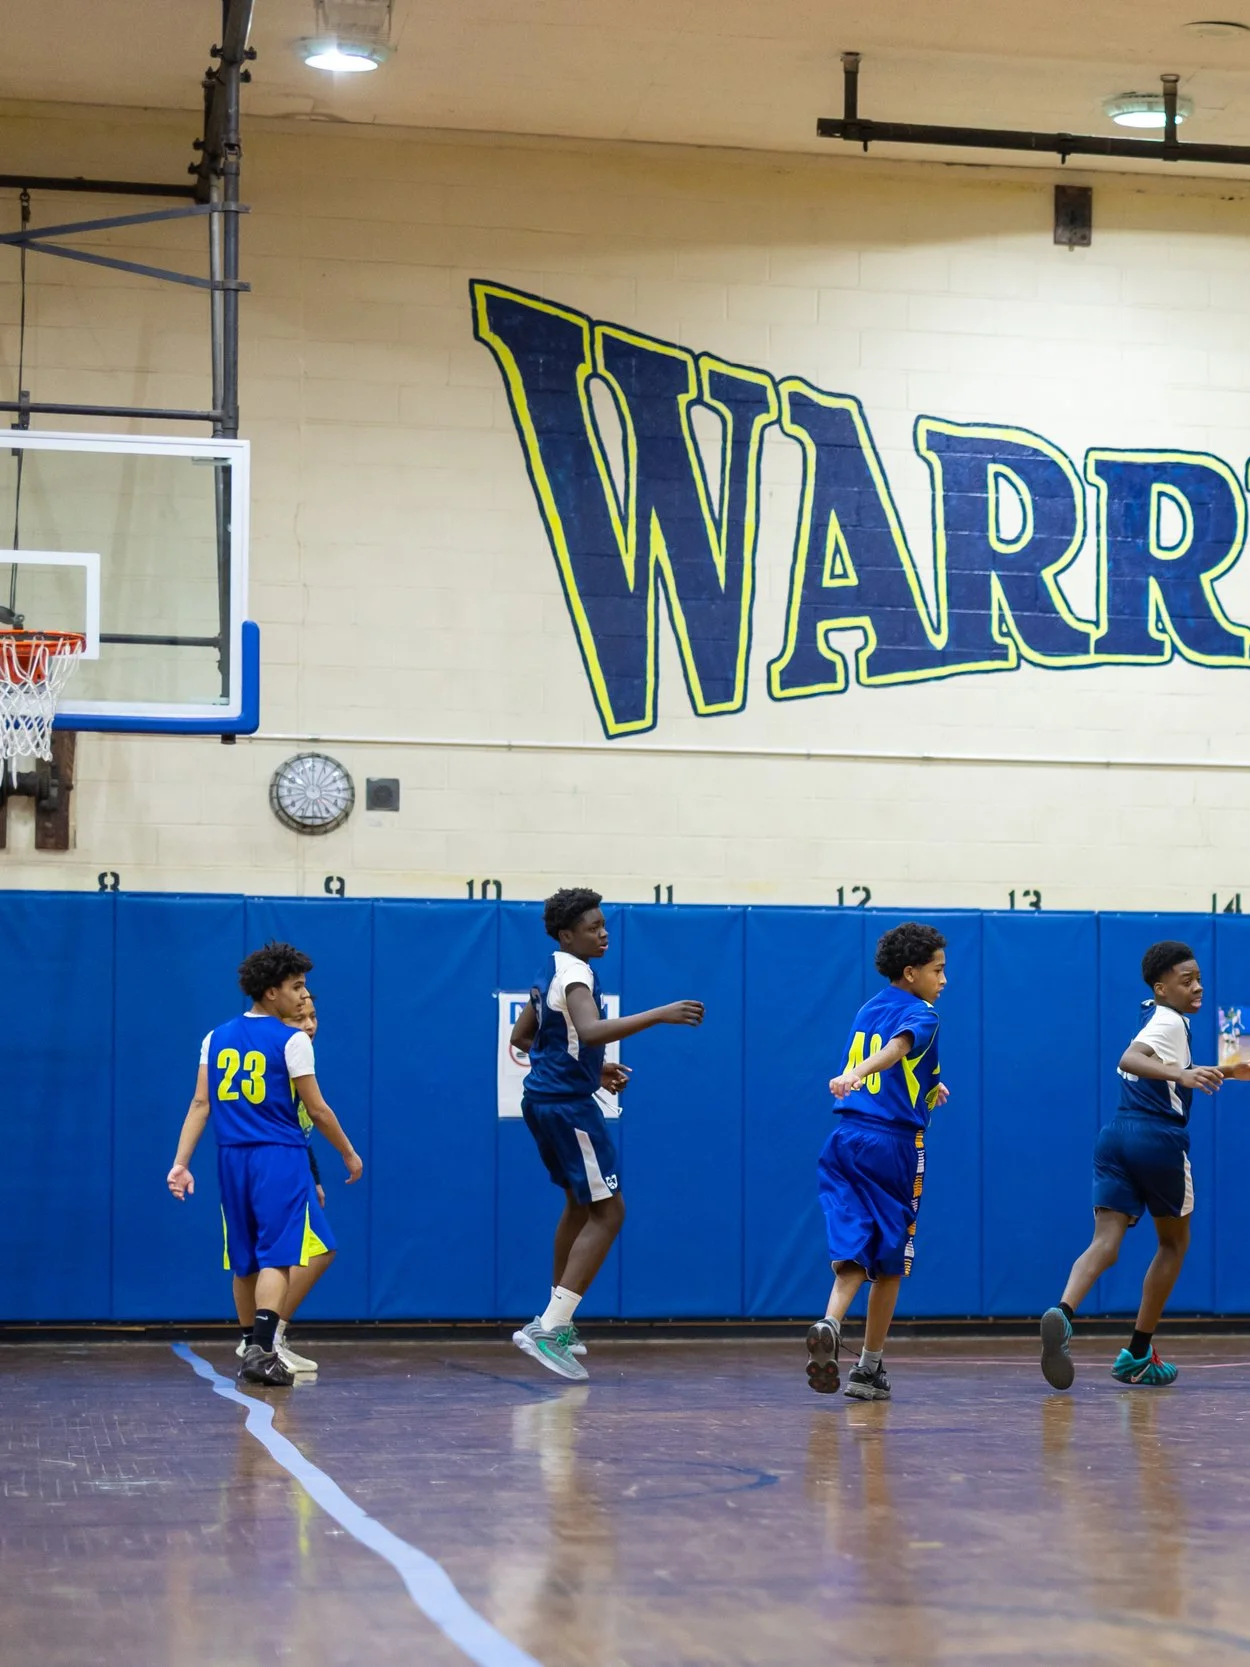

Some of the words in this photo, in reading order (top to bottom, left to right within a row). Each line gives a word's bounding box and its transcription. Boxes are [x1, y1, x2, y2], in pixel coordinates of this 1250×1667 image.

[654, 884, 673, 904] 11
[837, 886, 872, 907] 12
[1008, 889, 1042, 910] 13
[1212, 893, 1242, 914] 14
[217, 1047, 267, 1105] 23
